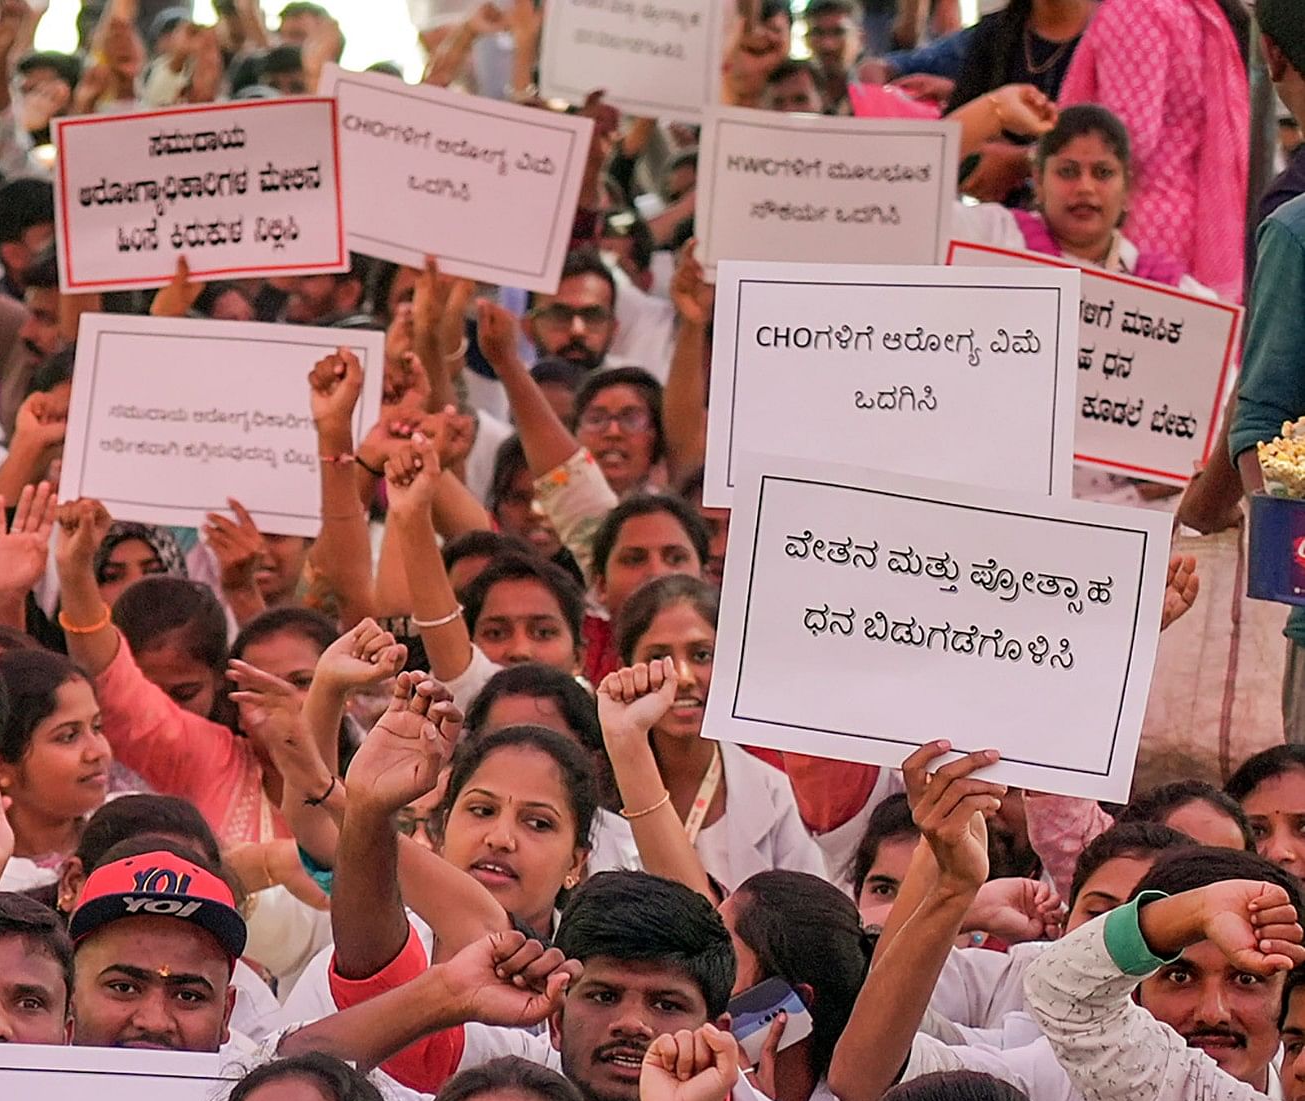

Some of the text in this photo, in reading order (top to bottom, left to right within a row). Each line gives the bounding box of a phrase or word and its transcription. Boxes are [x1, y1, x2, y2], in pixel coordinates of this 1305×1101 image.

[149, 128, 246, 157] ಸಮುದಾಯ
[756, 324, 1041, 367] CHOಗಳಿಗೆ ಆರೋಗ್ಯ ವಿಮೆ
[1102, 352, 1134, 380] ಧನ
[854, 385, 938, 411] ಒದಗಿಸಿ
[1150, 403, 1197, 440] ಬೇಕು
[784, 529, 879, 568] ವೇತನ
[887, 545, 960, 594] ಮತ್ತು
[803, 603, 1075, 670] ಧನ ಬಿಡುಗಡೆಗೊಳಿಸಿ
